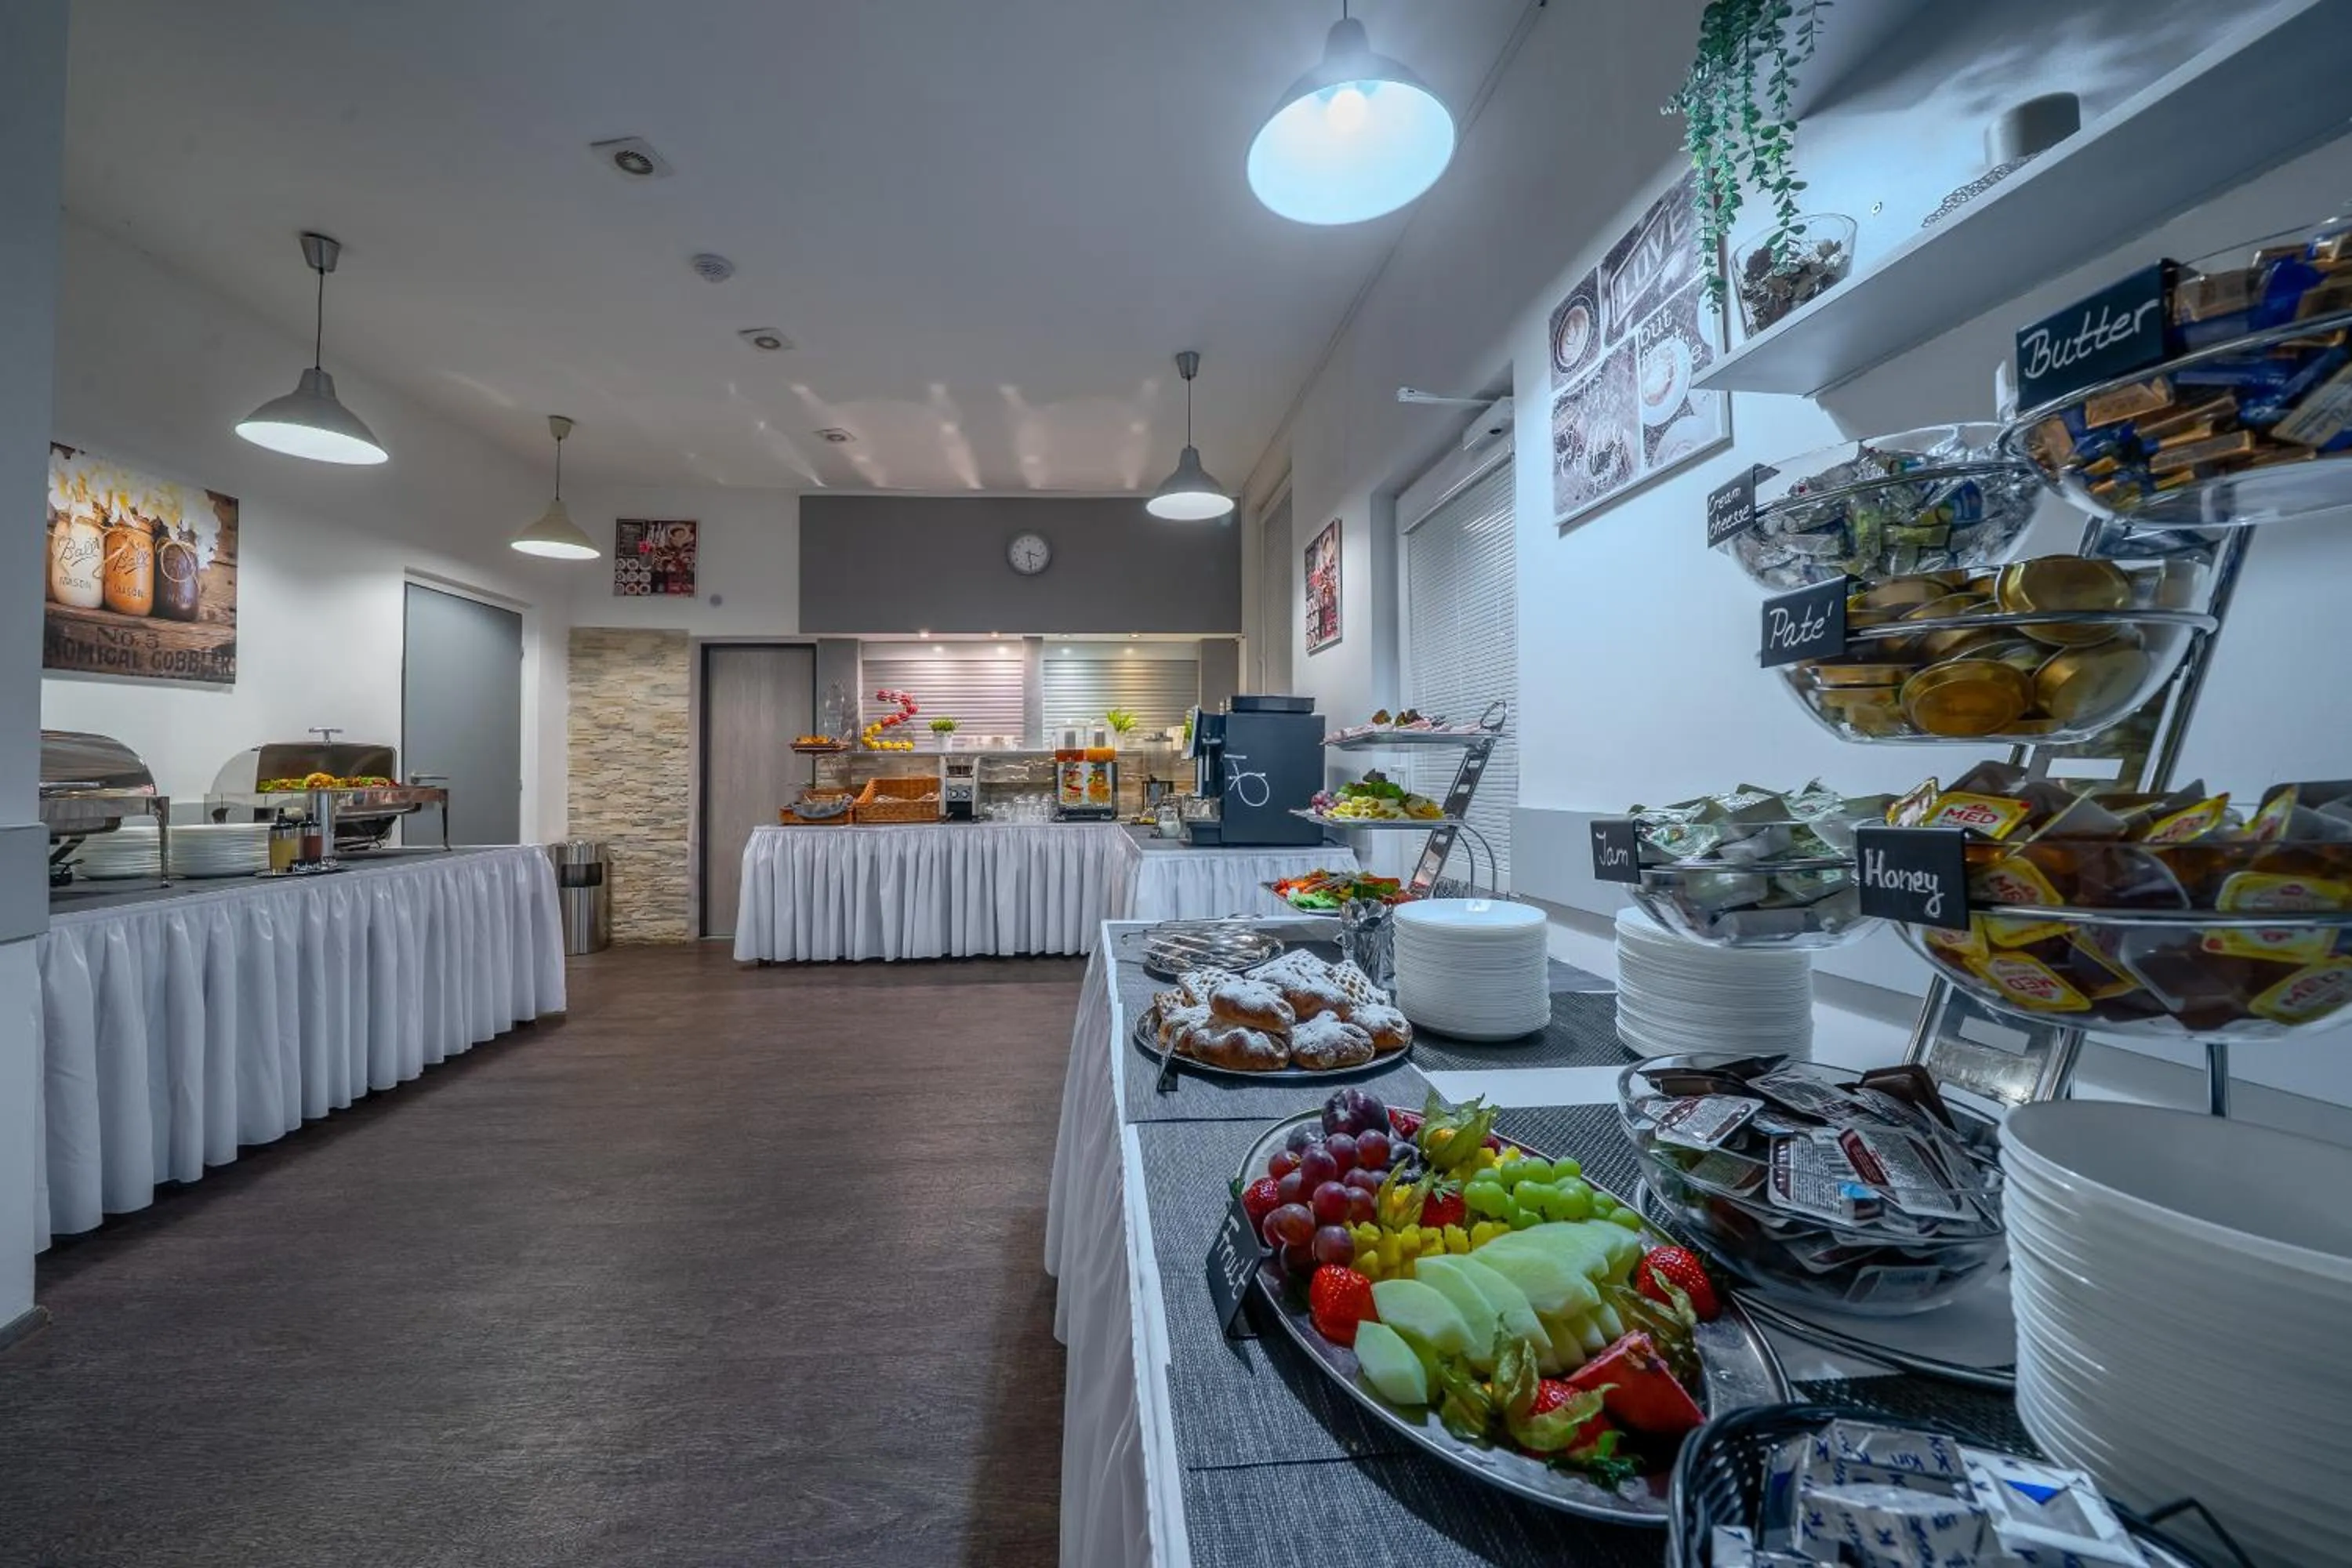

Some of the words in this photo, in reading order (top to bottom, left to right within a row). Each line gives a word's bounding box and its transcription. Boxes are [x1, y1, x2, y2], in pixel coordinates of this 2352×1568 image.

[1621, 194, 1688, 305] LOVE
[2021, 299, 2160, 379] Butter
[1595, 831, 1628, 866] Jam
[1944, 807, 1999, 825] MED
[1864, 848, 1945, 918] Honey
[1216, 1214, 1254, 1301] Fruit
